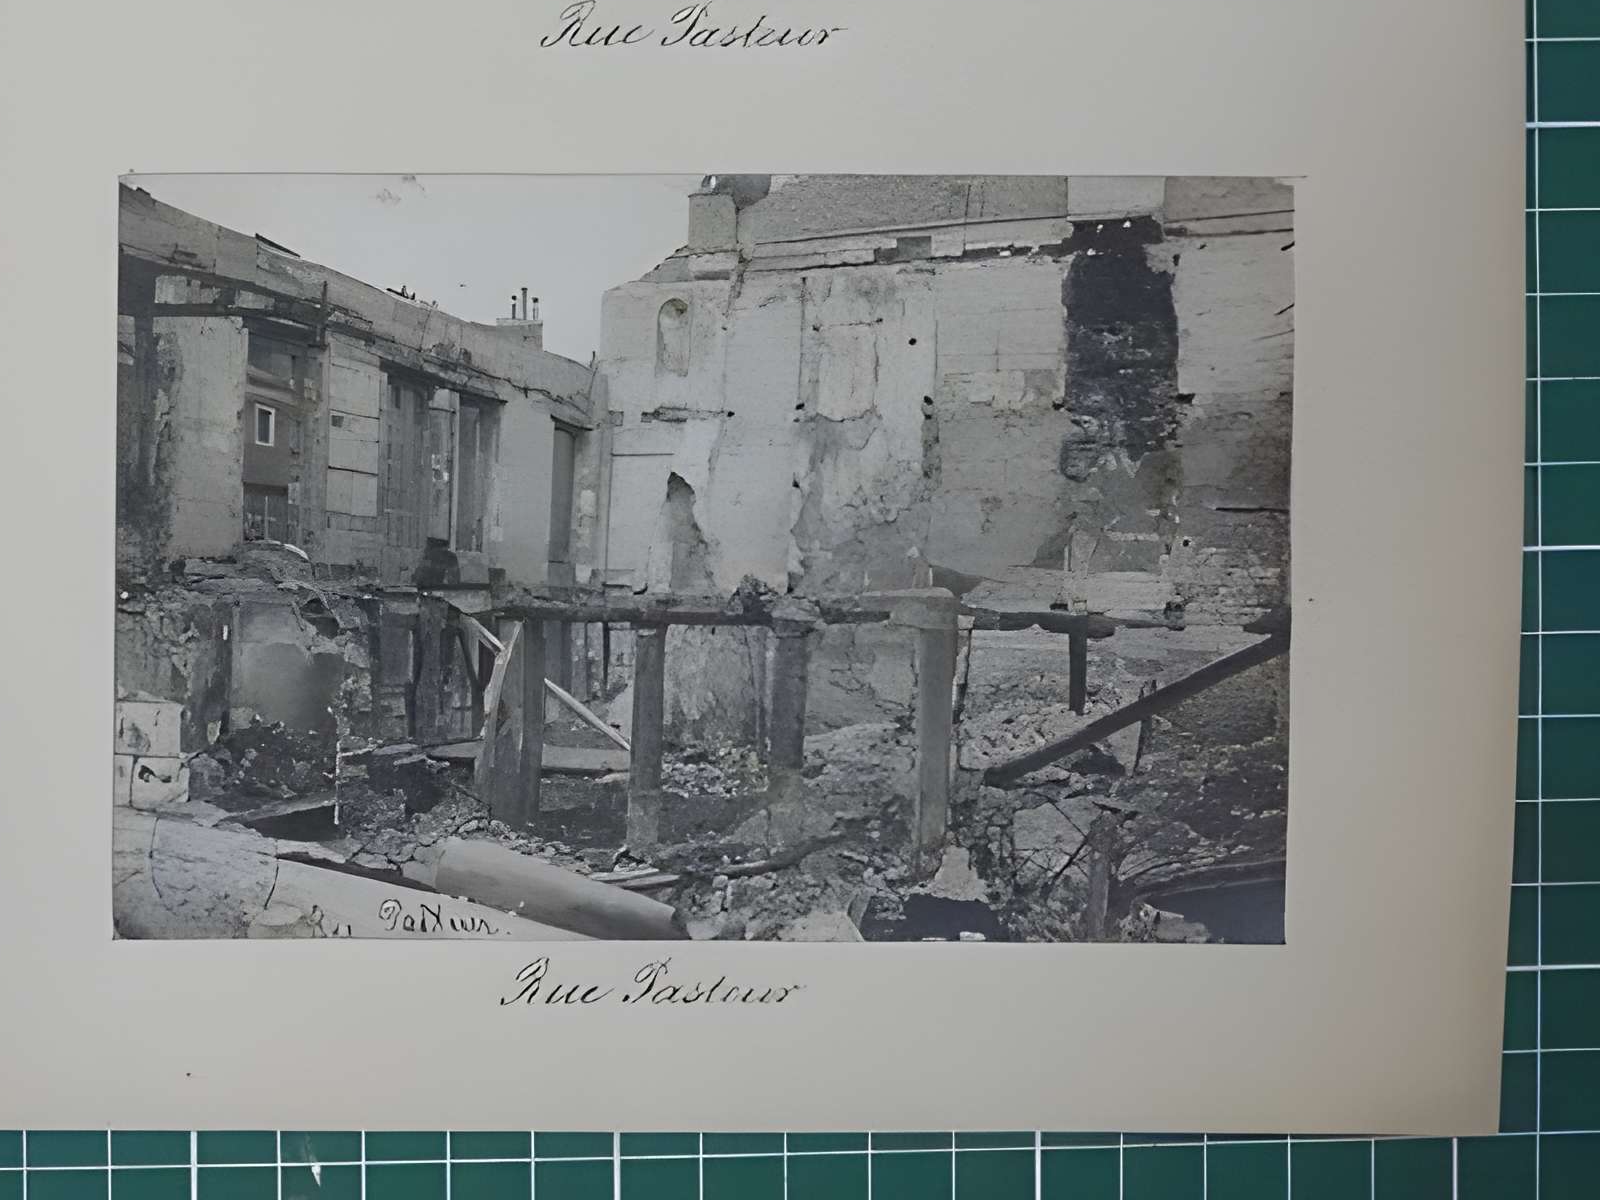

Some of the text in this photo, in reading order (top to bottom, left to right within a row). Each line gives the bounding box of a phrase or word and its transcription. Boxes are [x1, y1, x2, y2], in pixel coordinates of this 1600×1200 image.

[540, 0, 849, 48] Rue Pasteur
[500, 957, 615, 1007] Rue
